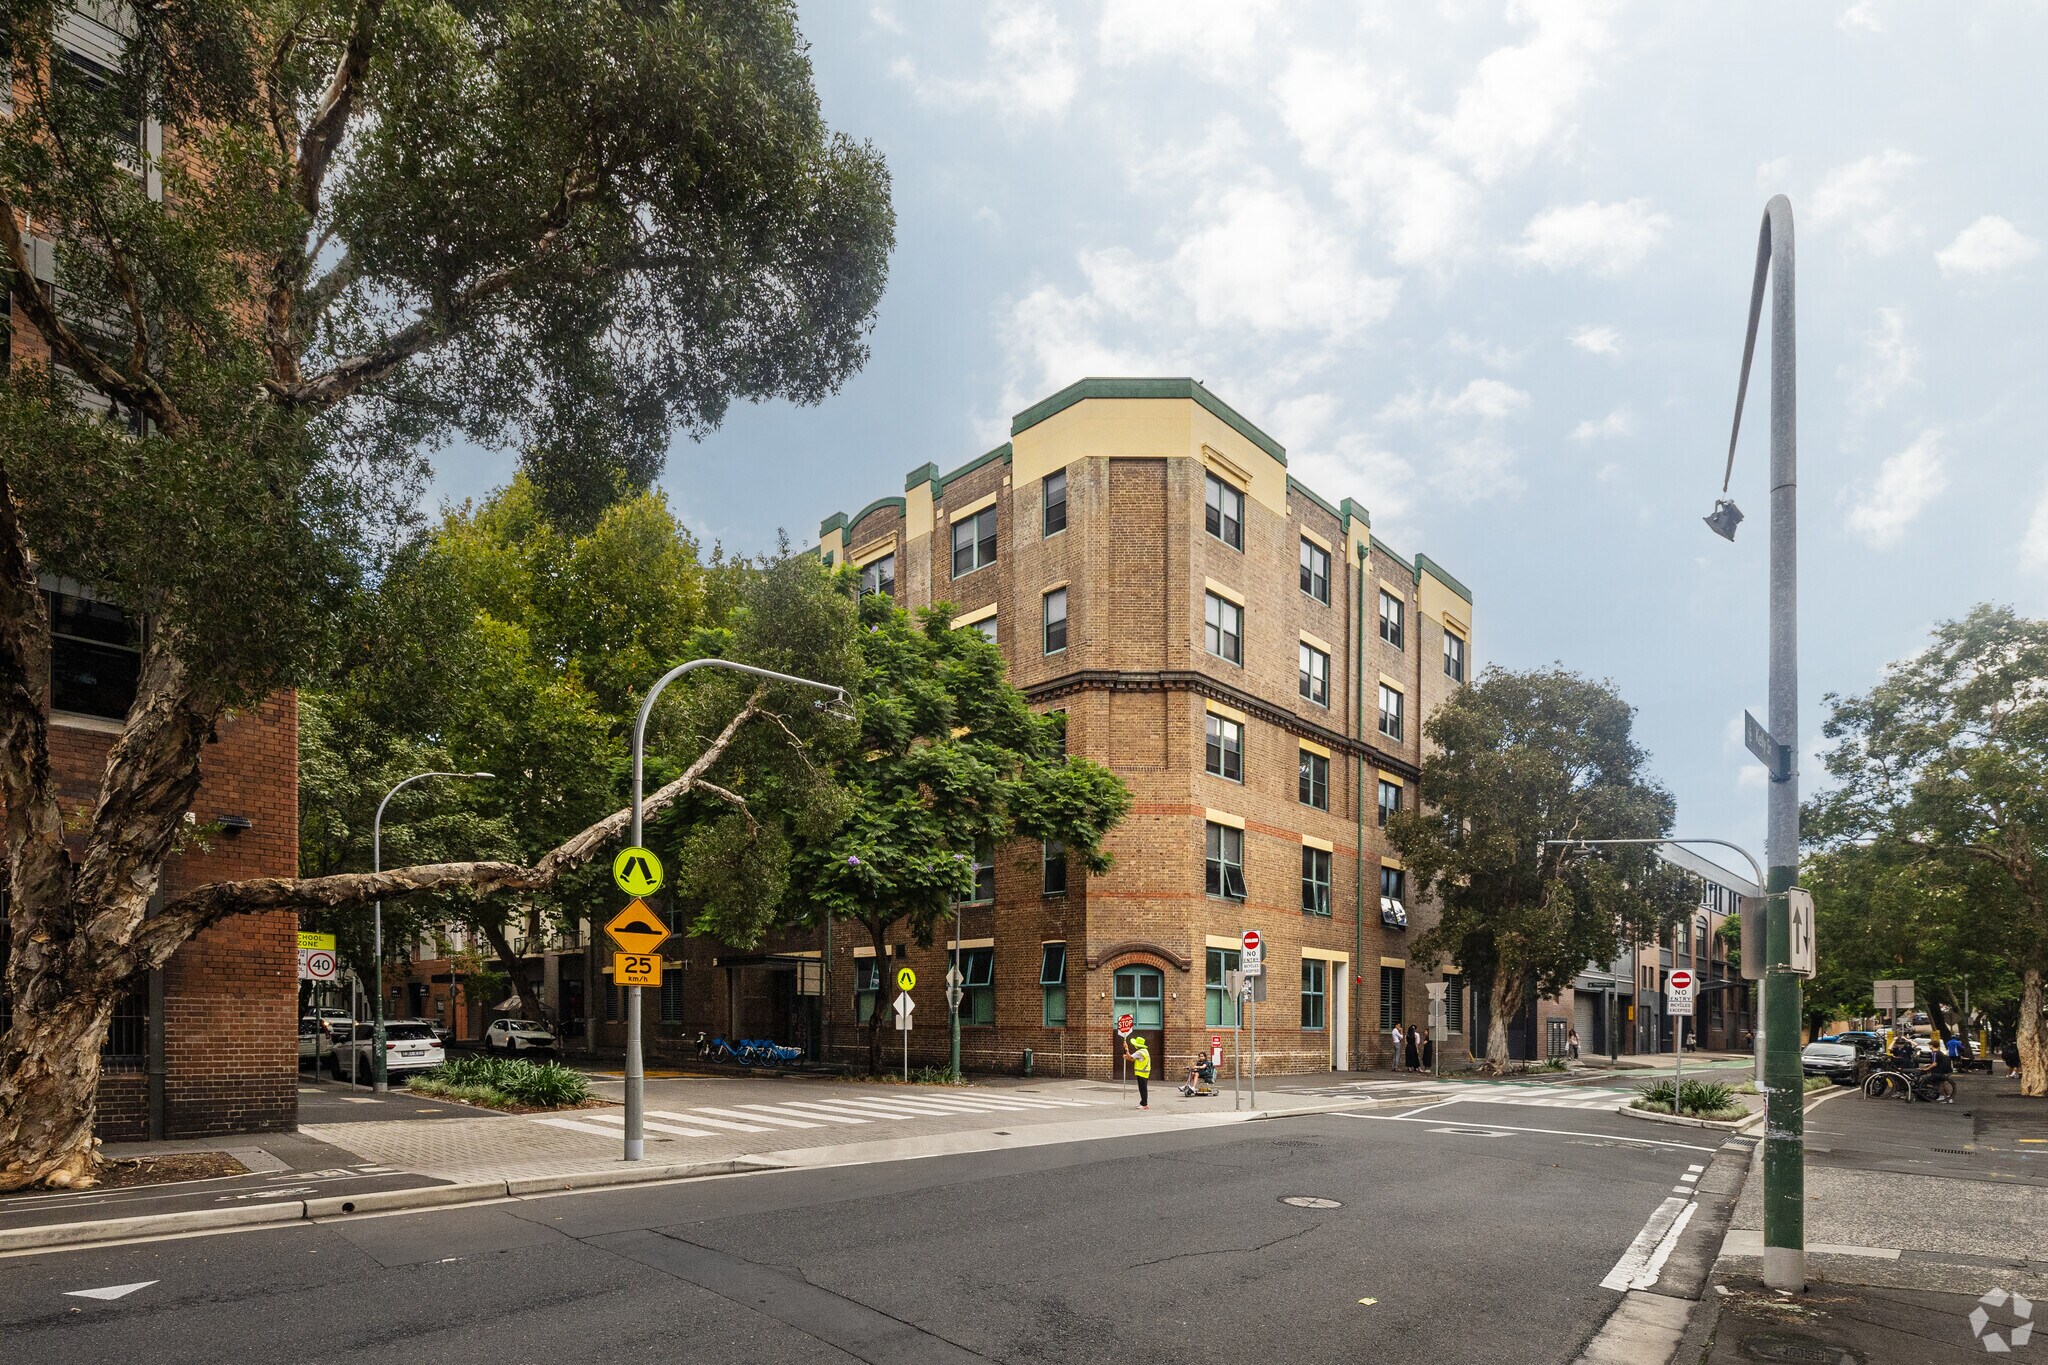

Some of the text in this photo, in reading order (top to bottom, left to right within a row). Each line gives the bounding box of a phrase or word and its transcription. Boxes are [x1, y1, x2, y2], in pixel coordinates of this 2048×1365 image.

[297, 933, 323, 941] CHOOL
[312, 959, 330, 971] 40
[624, 956, 652, 974] 25
[628, 975, 648, 983] km/h
[1118, 1019, 1133, 1029] STOP
